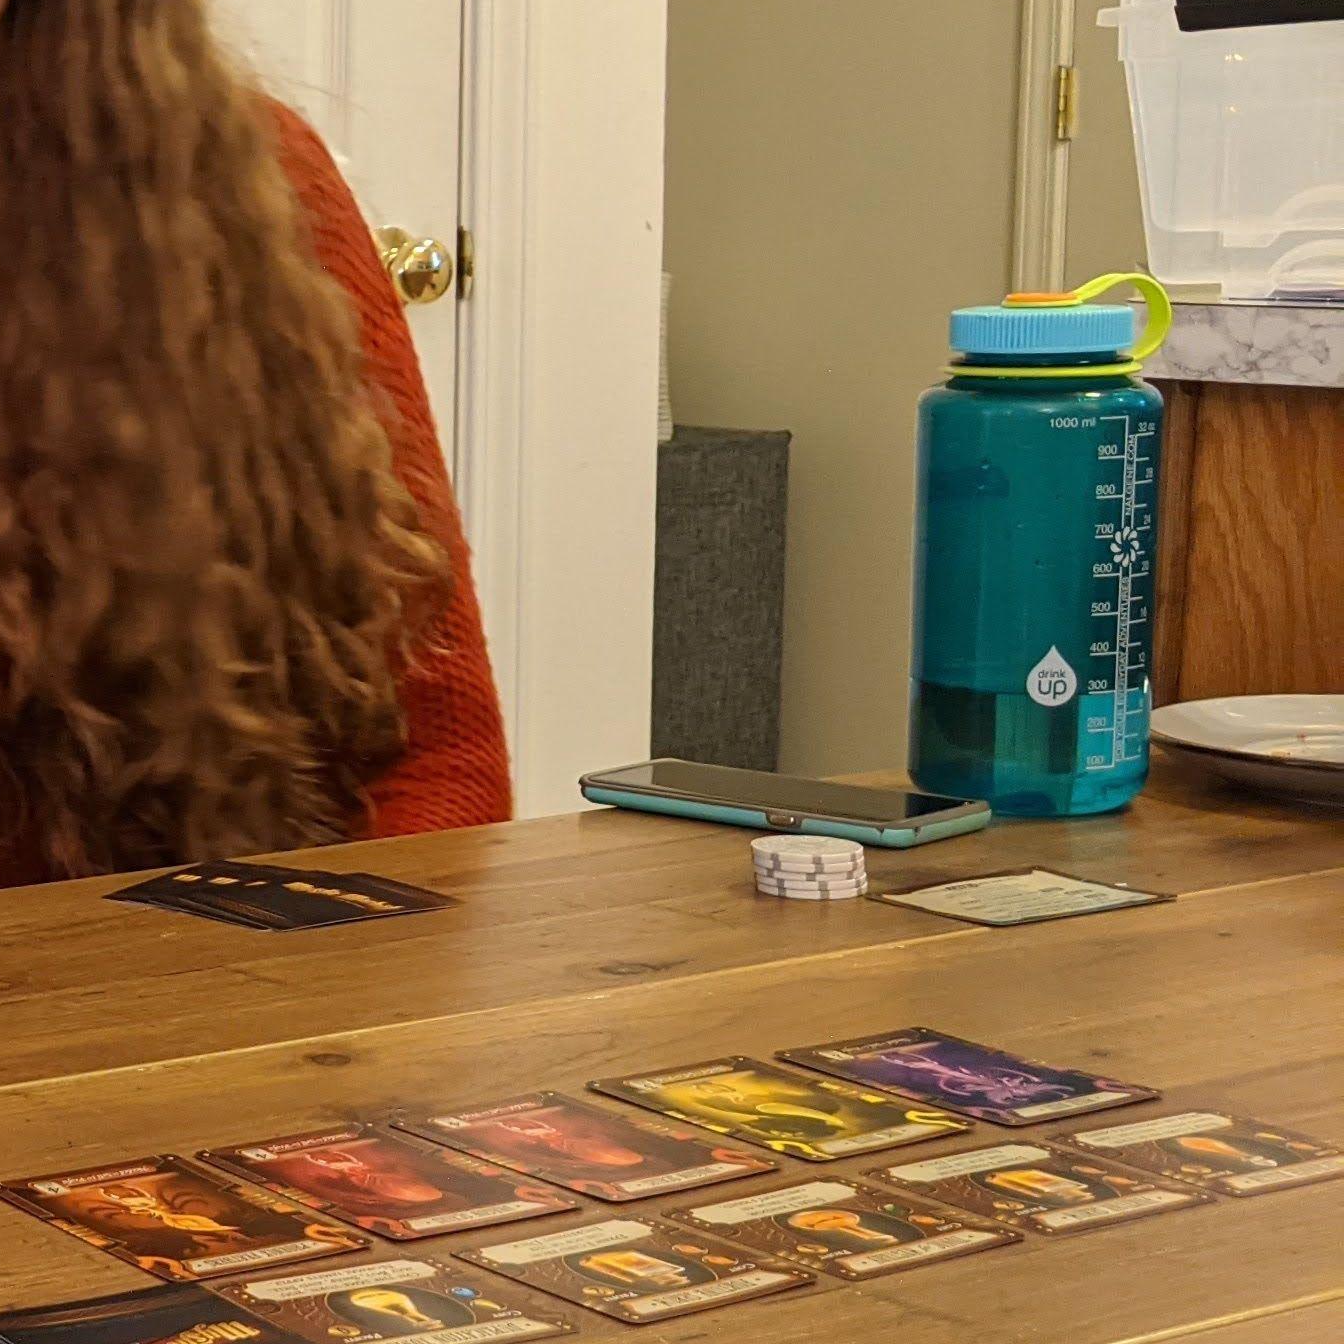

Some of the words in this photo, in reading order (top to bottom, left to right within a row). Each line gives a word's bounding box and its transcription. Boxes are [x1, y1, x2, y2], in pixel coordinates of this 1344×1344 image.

[1049, 417, 1079, 429] 1000
[1097, 444, 1118, 456] 900
[1095, 484, 1115, 496] 800
[1094, 523, 1115, 535] 700
[1092, 563, 1113, 574] 600
[1090, 602, 1111, 613] 500
[1089, 641, 1110, 653] 400
[1037, 669, 1067, 679] drink
[1087, 679, 1108, 691] 300
